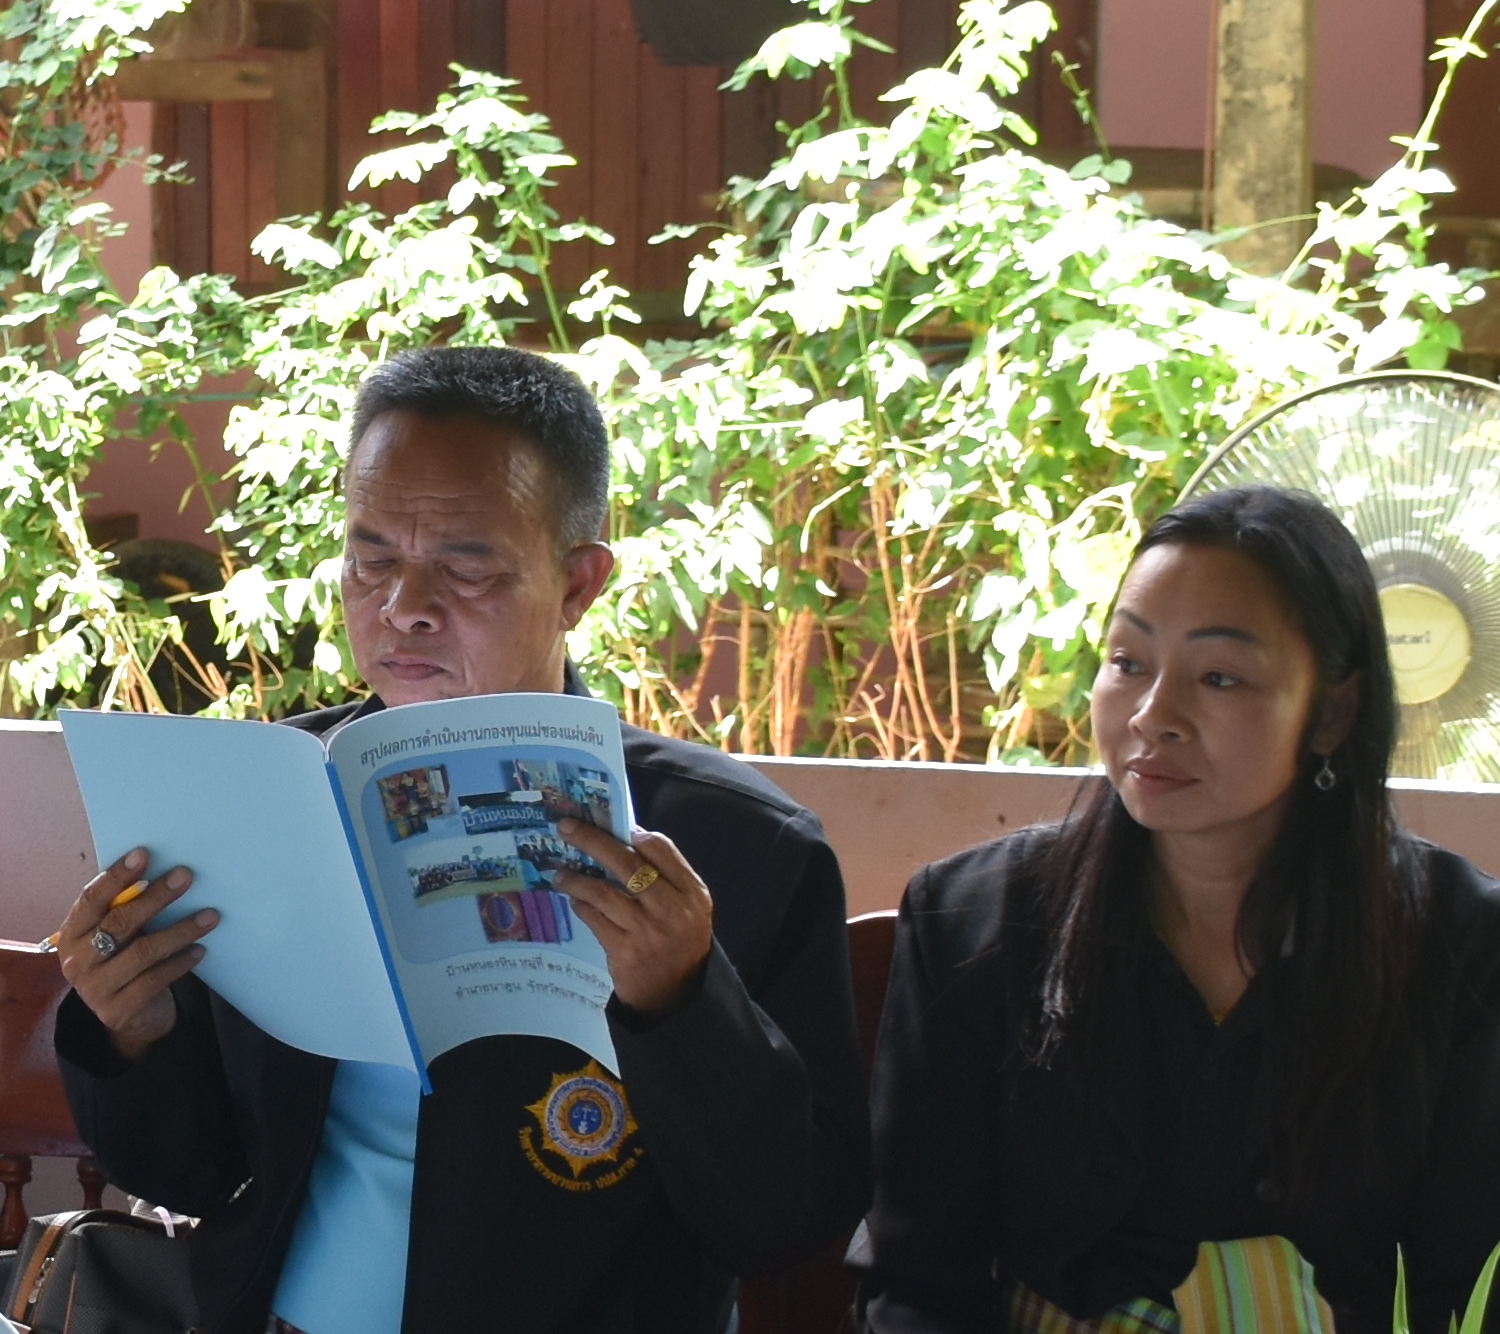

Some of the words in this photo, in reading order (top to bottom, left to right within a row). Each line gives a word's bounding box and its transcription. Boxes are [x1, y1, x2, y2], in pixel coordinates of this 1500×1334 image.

[360, 721, 605, 768] สรุปผลการดำเนินงานกองทุนแม่ของแผ่นดิน
